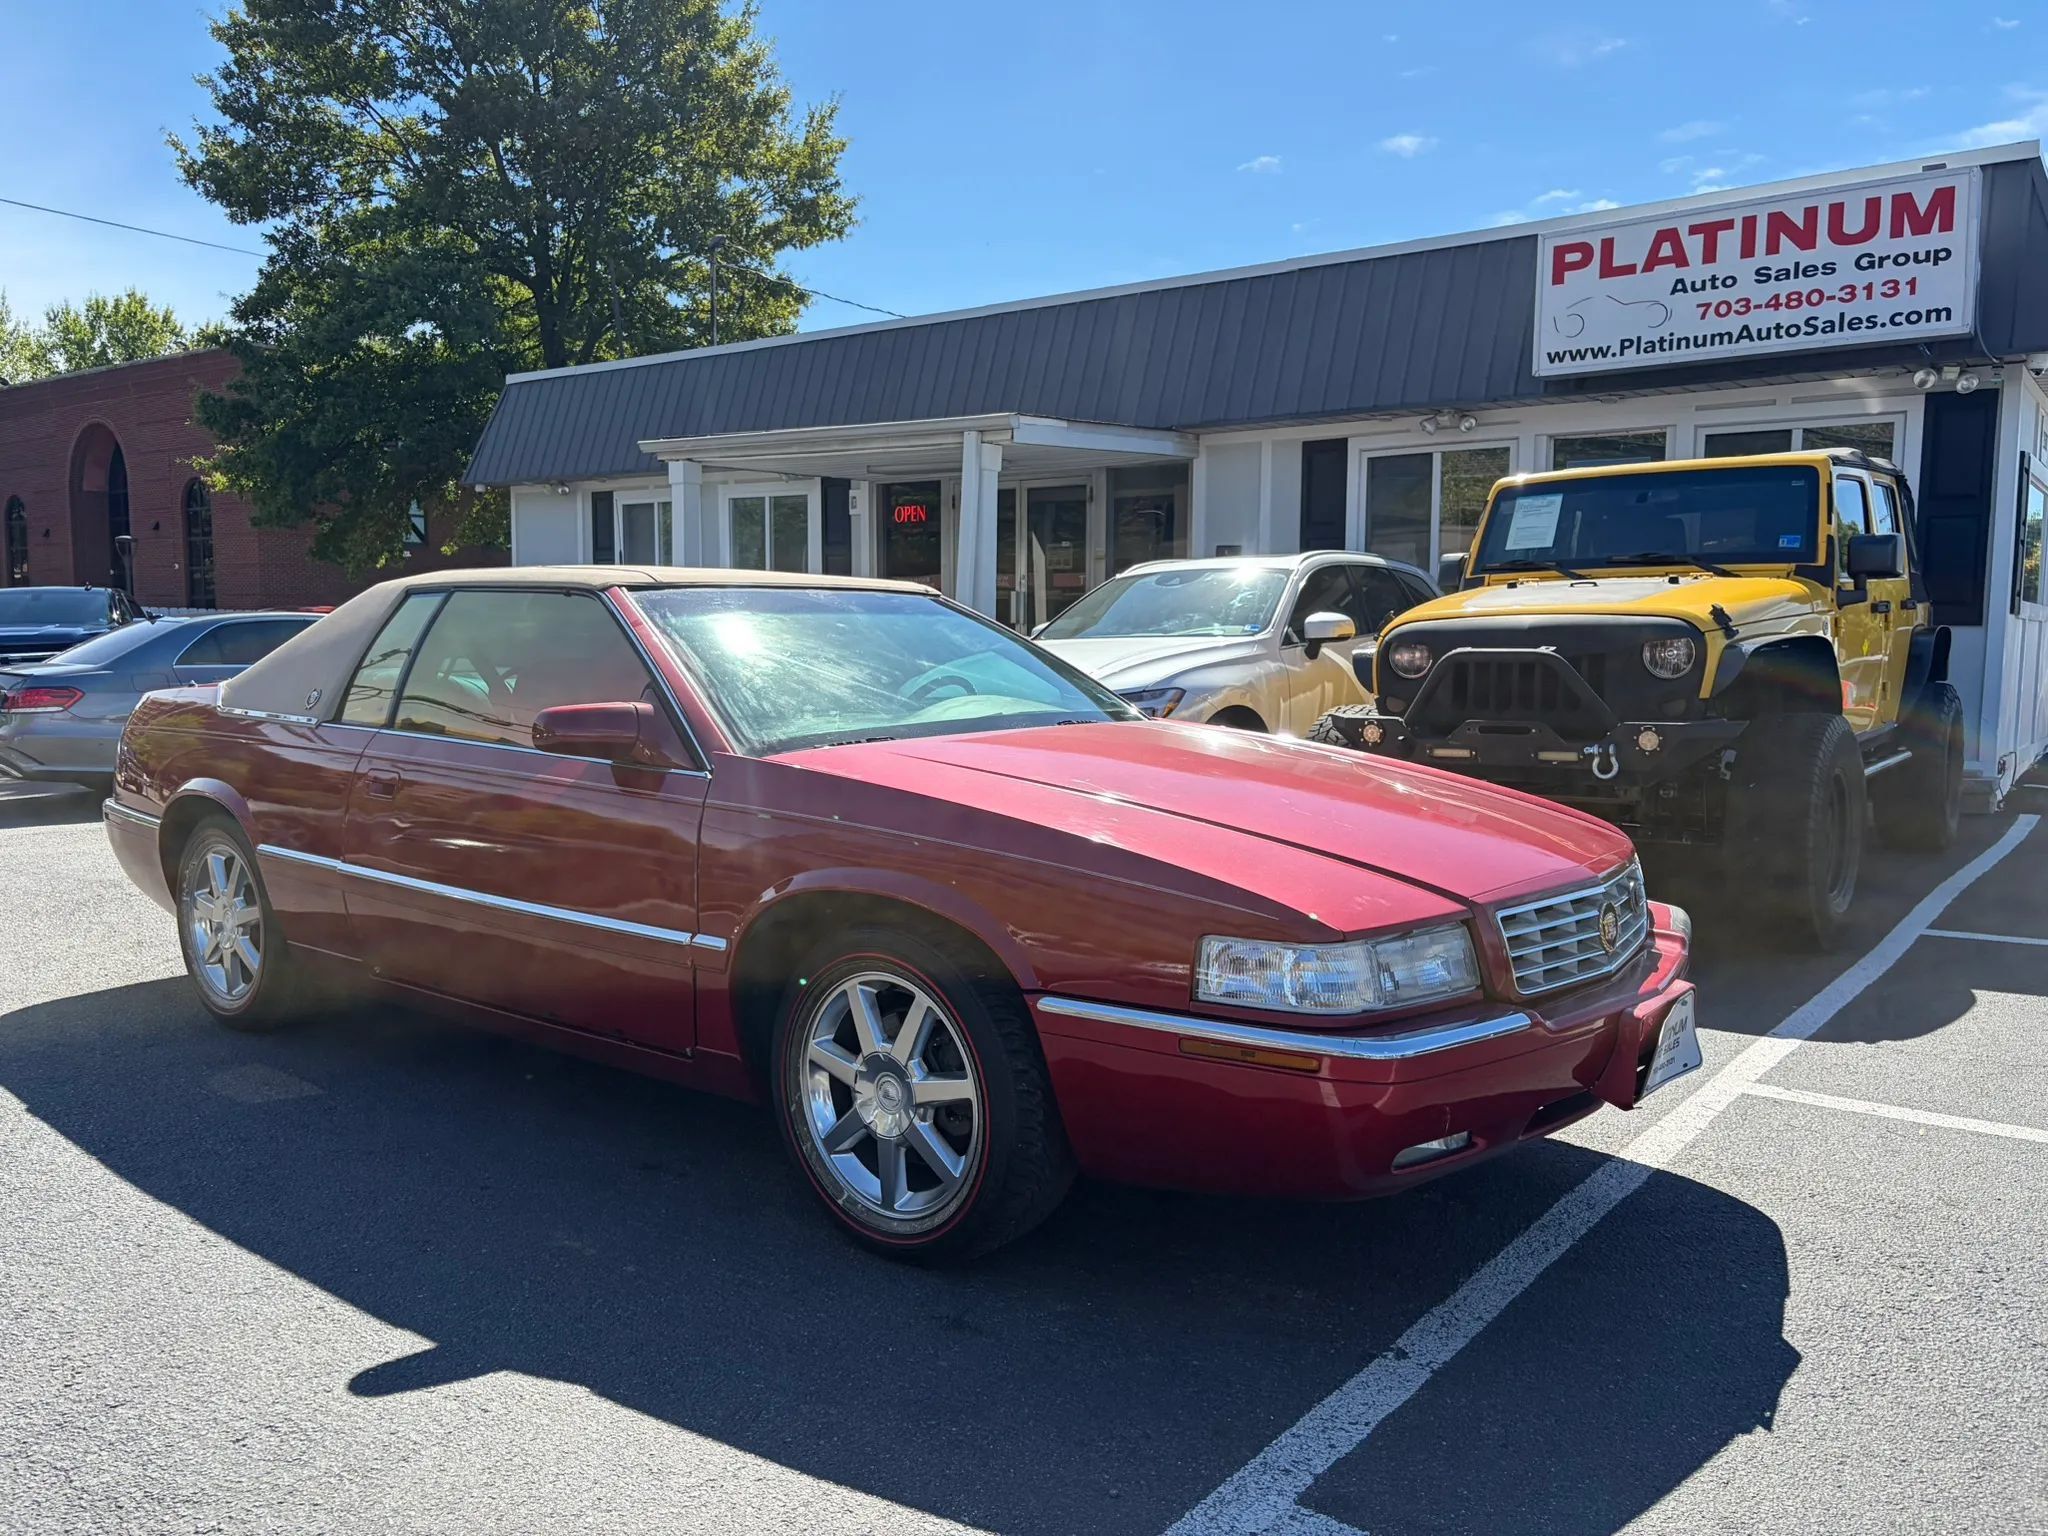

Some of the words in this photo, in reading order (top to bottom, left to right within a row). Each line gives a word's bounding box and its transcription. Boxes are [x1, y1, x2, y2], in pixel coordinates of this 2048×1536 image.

[1552, 186, 1956, 286] PLATINUM
[1669, 273, 1738, 296] Auto
[1753, 261, 1838, 285] Sales
[1854, 247, 1952, 271] Group
[1695, 276, 1918, 321] 703-480-3131
[1546, 306, 1952, 364] www.PlatinumAutoSales.com
[894, 504, 926, 523] OPEN
